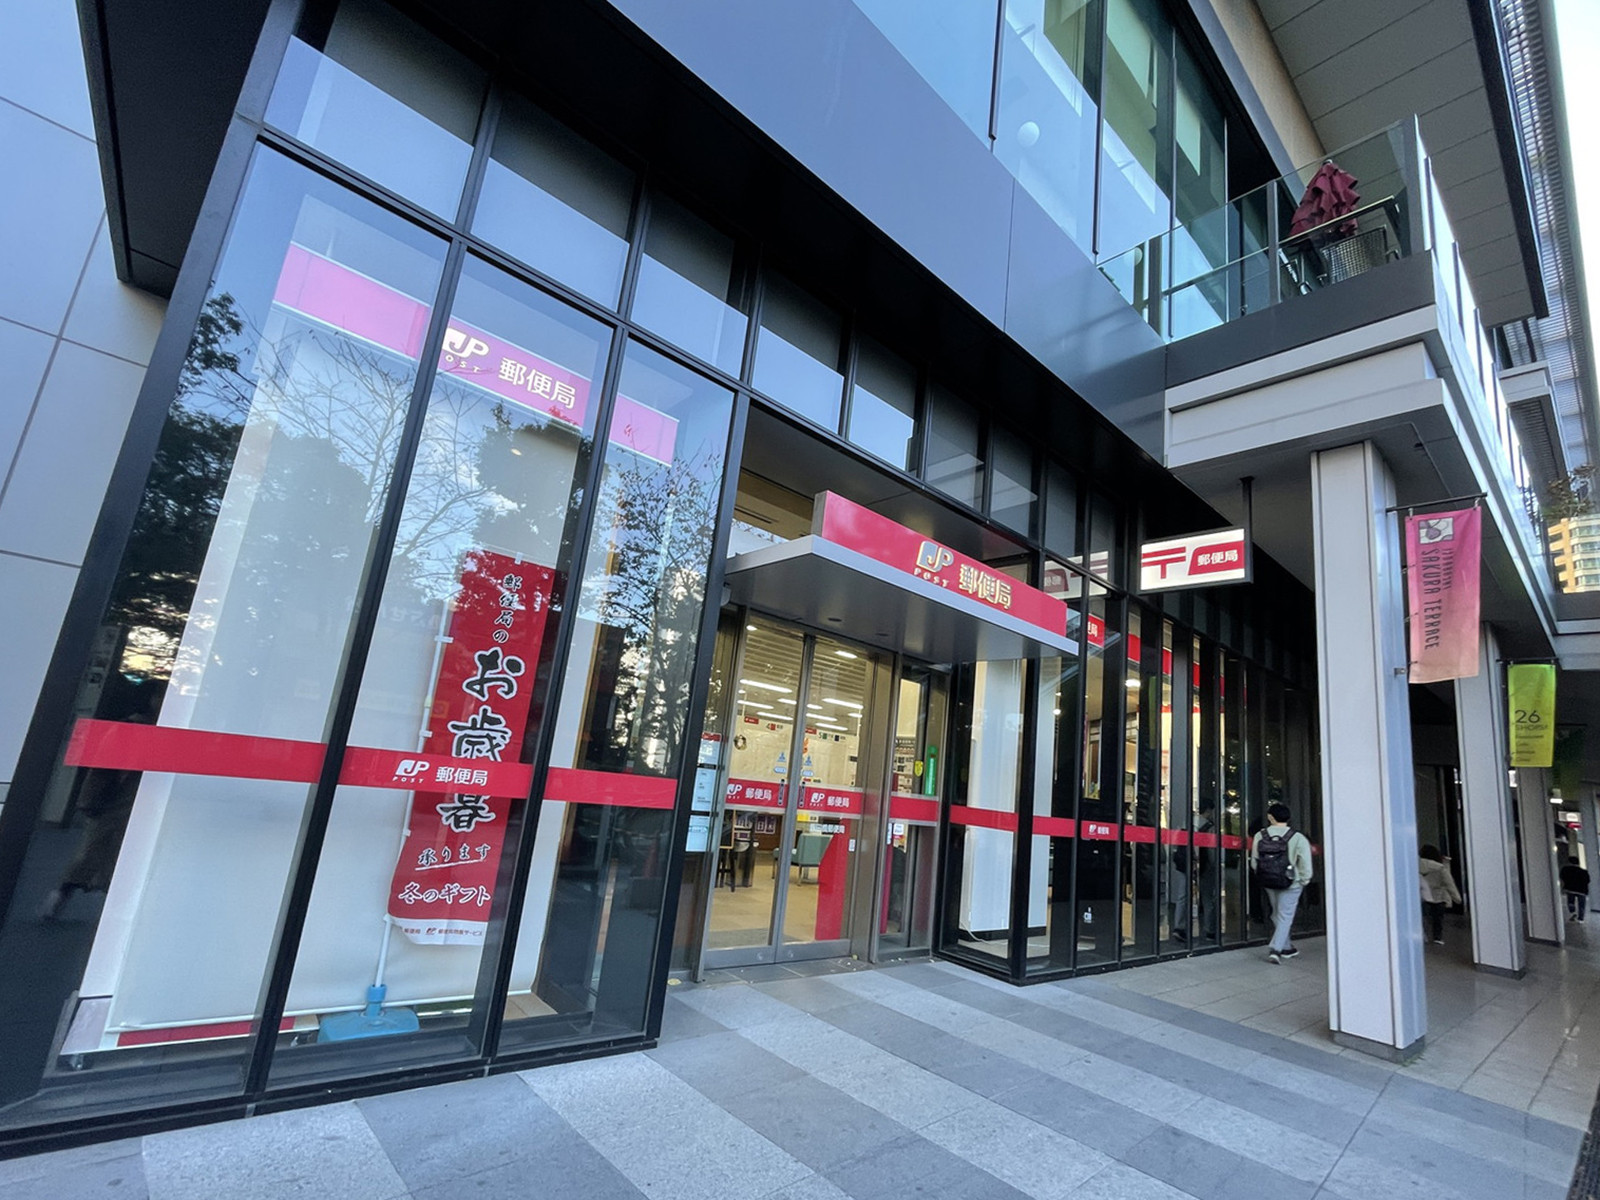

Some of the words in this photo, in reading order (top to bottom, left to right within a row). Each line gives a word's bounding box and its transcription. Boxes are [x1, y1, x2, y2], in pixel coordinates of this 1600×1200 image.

[498, 357, 576, 409] 郵便局
[916, 540, 954, 573] JP
[1197, 549, 1239, 567] 郵便局
[913, 567, 950, 588] POST
[1421, 548, 1442, 594] SAKURA
[958, 563, 1012, 610] 郵便局
[1423, 598, 1443, 650] TERRACE
[1515, 709, 1541, 723] 26
[395, 759, 430, 777] JP
[435, 766, 489, 787] 郵便局
[392, 776, 425, 784] POST
[745, 787, 772, 801] 郵便局
[811, 792, 825, 803] JP
[827, 796, 850, 808] 郵便局
[418, 843, 491, 867] 承ります
[398, 881, 491, 906] 冬のギフト
